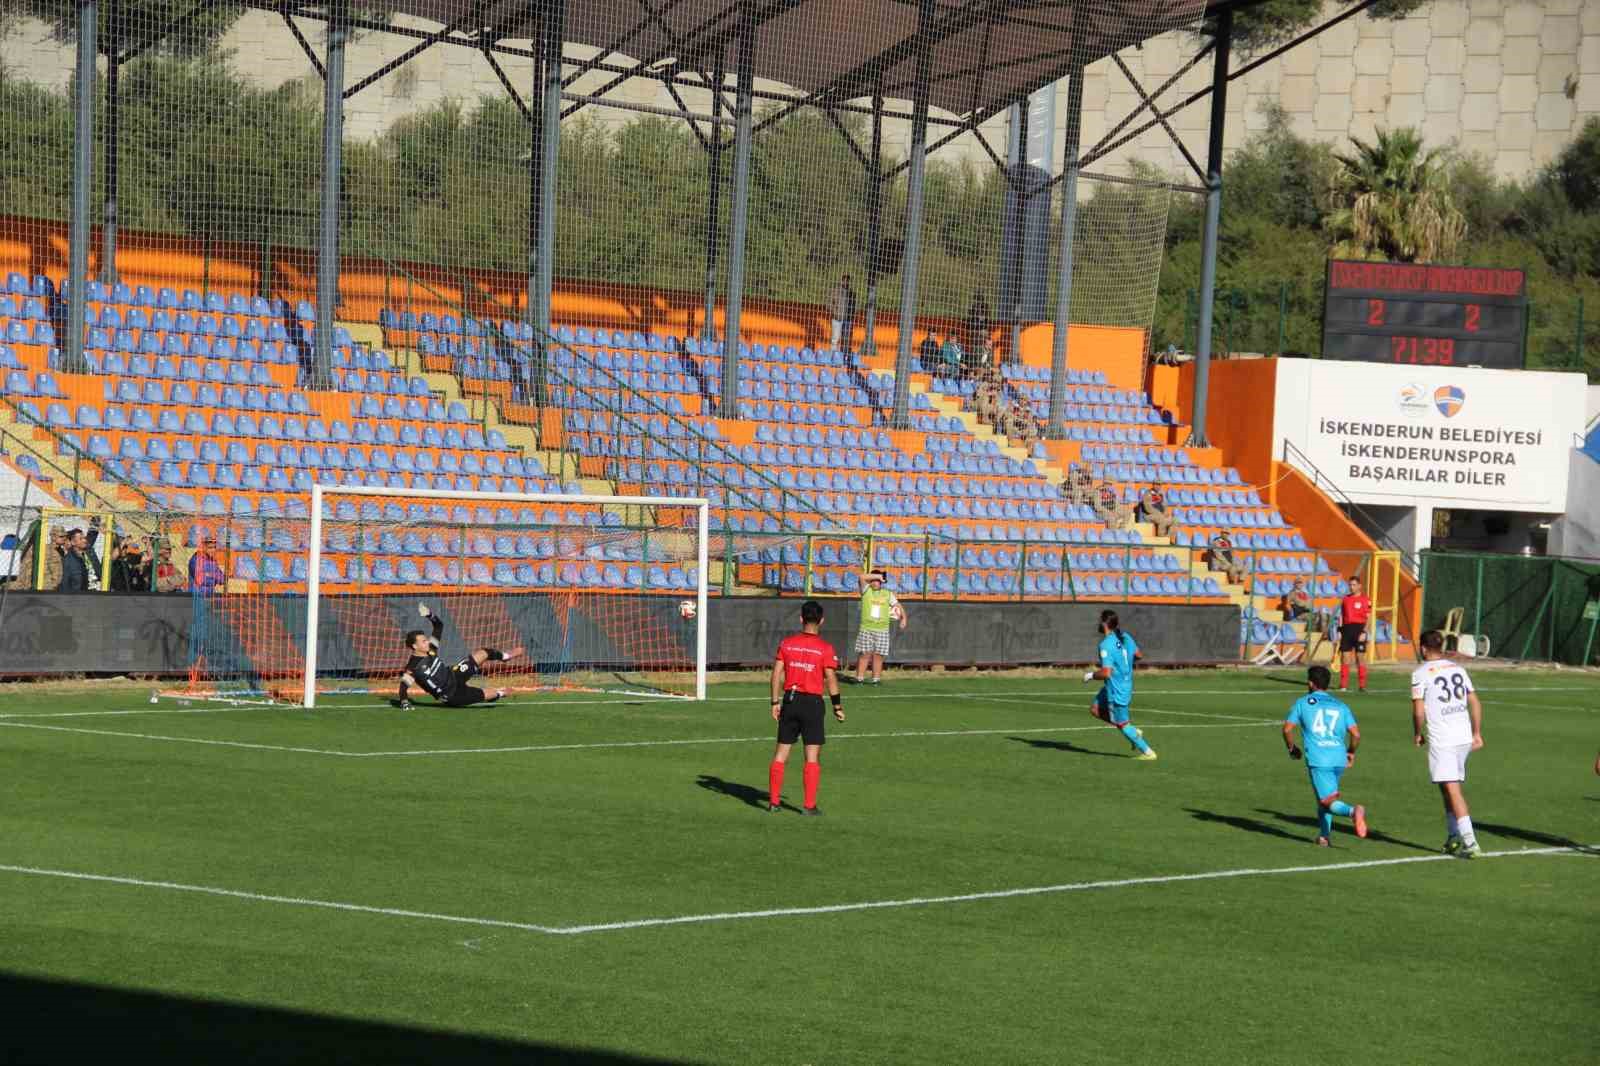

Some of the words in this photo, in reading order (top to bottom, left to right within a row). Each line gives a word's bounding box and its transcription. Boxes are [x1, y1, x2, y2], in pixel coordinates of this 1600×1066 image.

[1368, 300, 1384, 325] 2
[1465, 304, 1480, 331] 2
[1320, 416, 1433, 440] İSKENDERUN
[1439, 426, 1542, 445] BELEDİYESİ
[1341, 441, 1517, 466] İSKENDERUNSPORA
[1349, 465, 1449, 483] BAŞARILAR
[1454, 469, 1506, 486] DİLER
[1434, 673, 1465, 703] 38
[1312, 709, 1340, 737] 47
